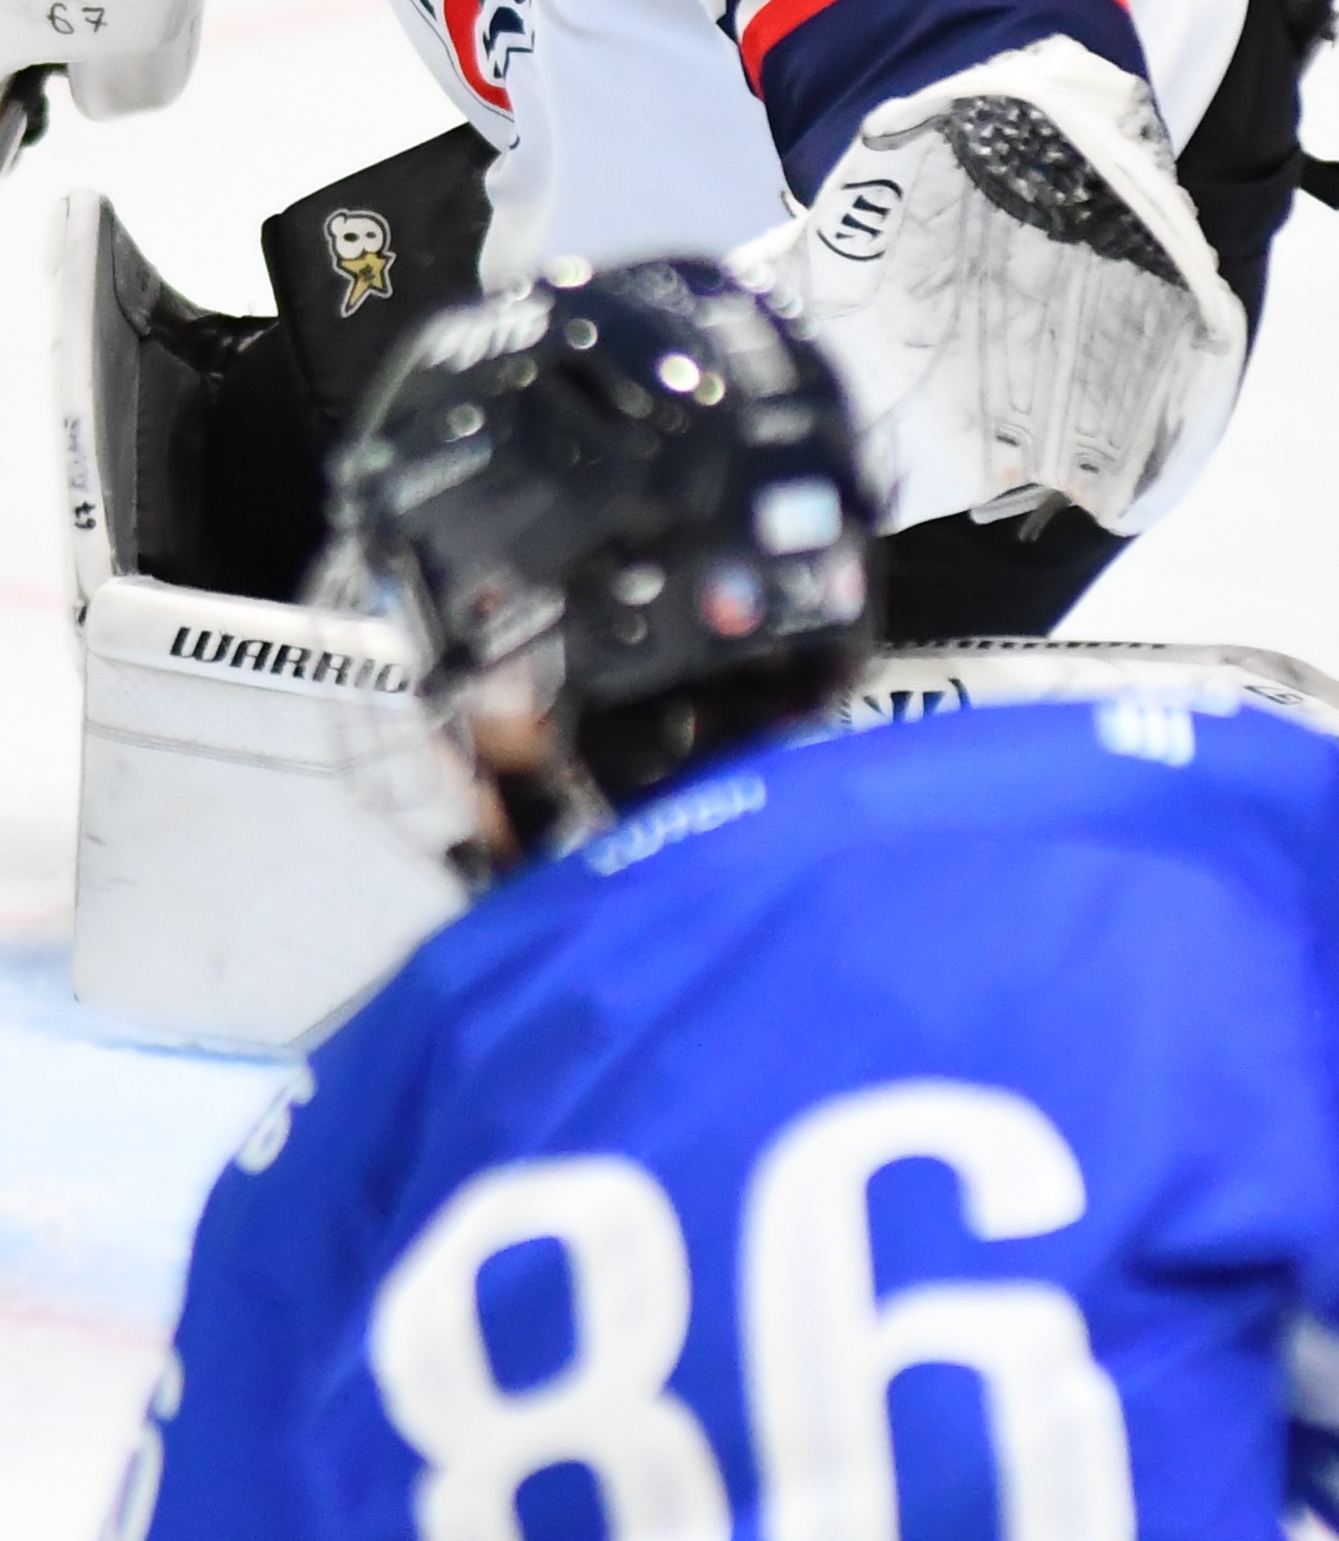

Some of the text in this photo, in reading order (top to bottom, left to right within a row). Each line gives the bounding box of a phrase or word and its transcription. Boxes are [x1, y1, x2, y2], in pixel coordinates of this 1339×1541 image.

[46, 2, 109, 35] 67
[169, 625, 416, 696] WARRIO
[366, 1072, 1141, 1541] 86
